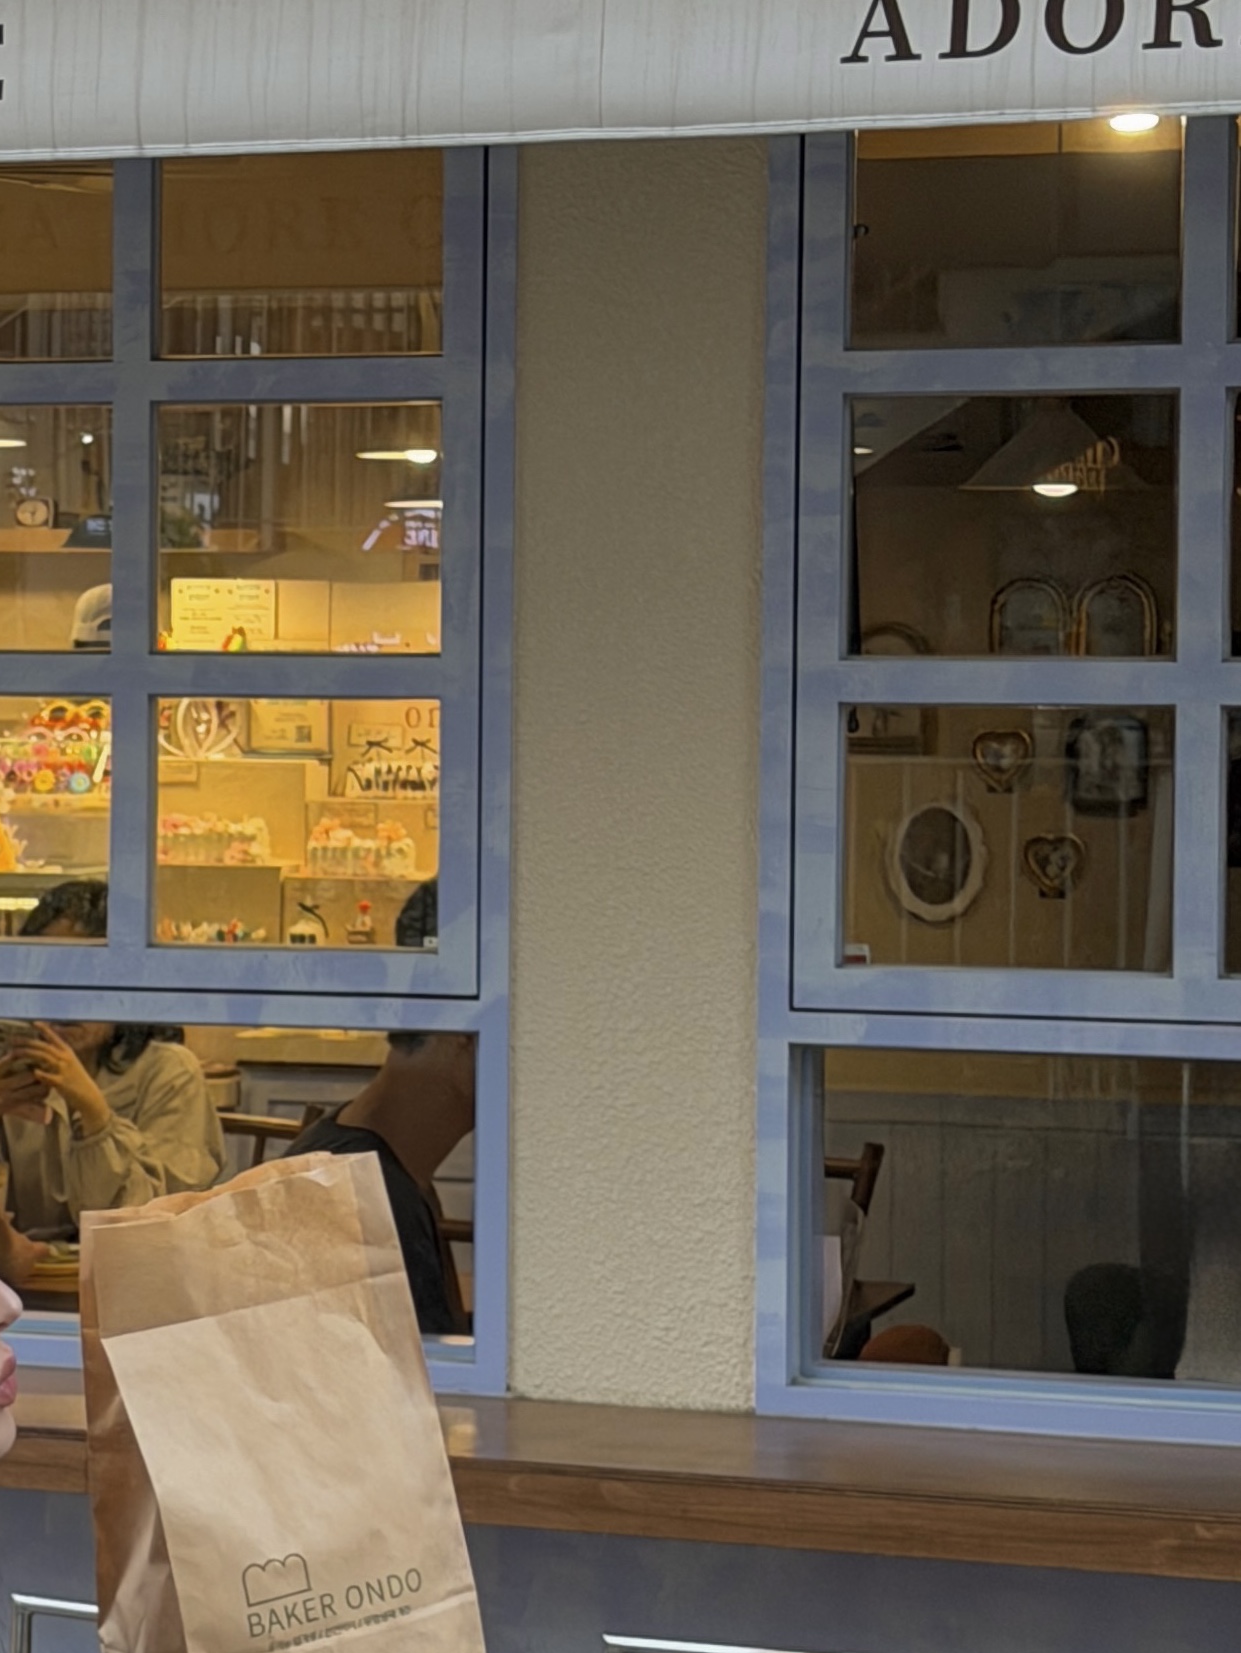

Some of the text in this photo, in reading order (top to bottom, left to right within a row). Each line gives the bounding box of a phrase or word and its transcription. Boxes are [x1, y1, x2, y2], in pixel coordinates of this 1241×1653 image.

[841, 0, 1241, 63] ADOR
[247, 1593, 337, 1638] BAKER
[346, 1568, 422, 1609] ONDO
